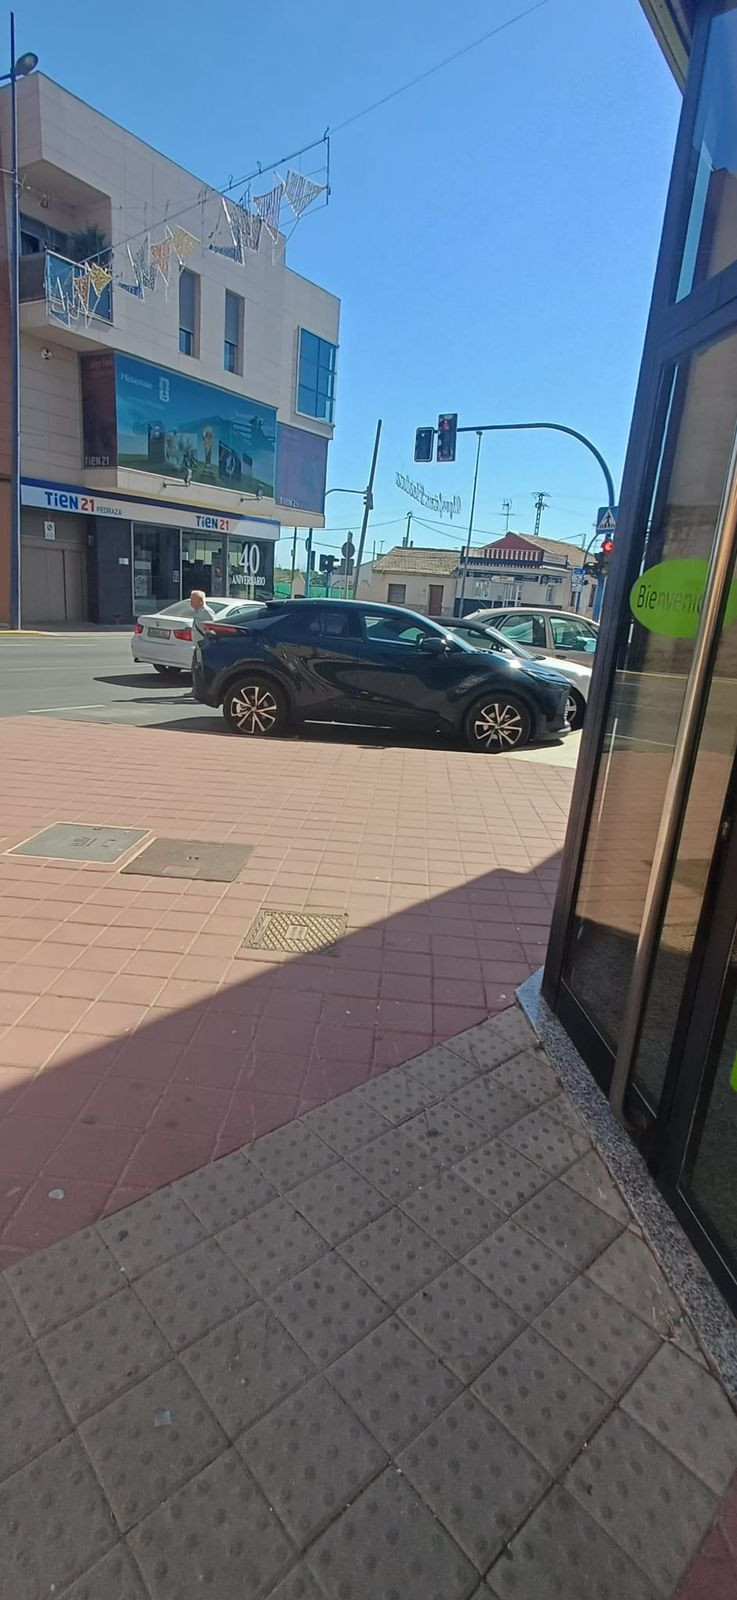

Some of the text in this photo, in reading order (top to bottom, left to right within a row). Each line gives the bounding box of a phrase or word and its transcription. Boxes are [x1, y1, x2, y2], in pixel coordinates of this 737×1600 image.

[80, 497, 96, 512] 21
[96, 506, 122, 516] PEDRAZA
[219, 519, 230, 531] 21
[240, 543, 260, 574] 40
[231, 574, 266, 587] ANIVERSARIO
